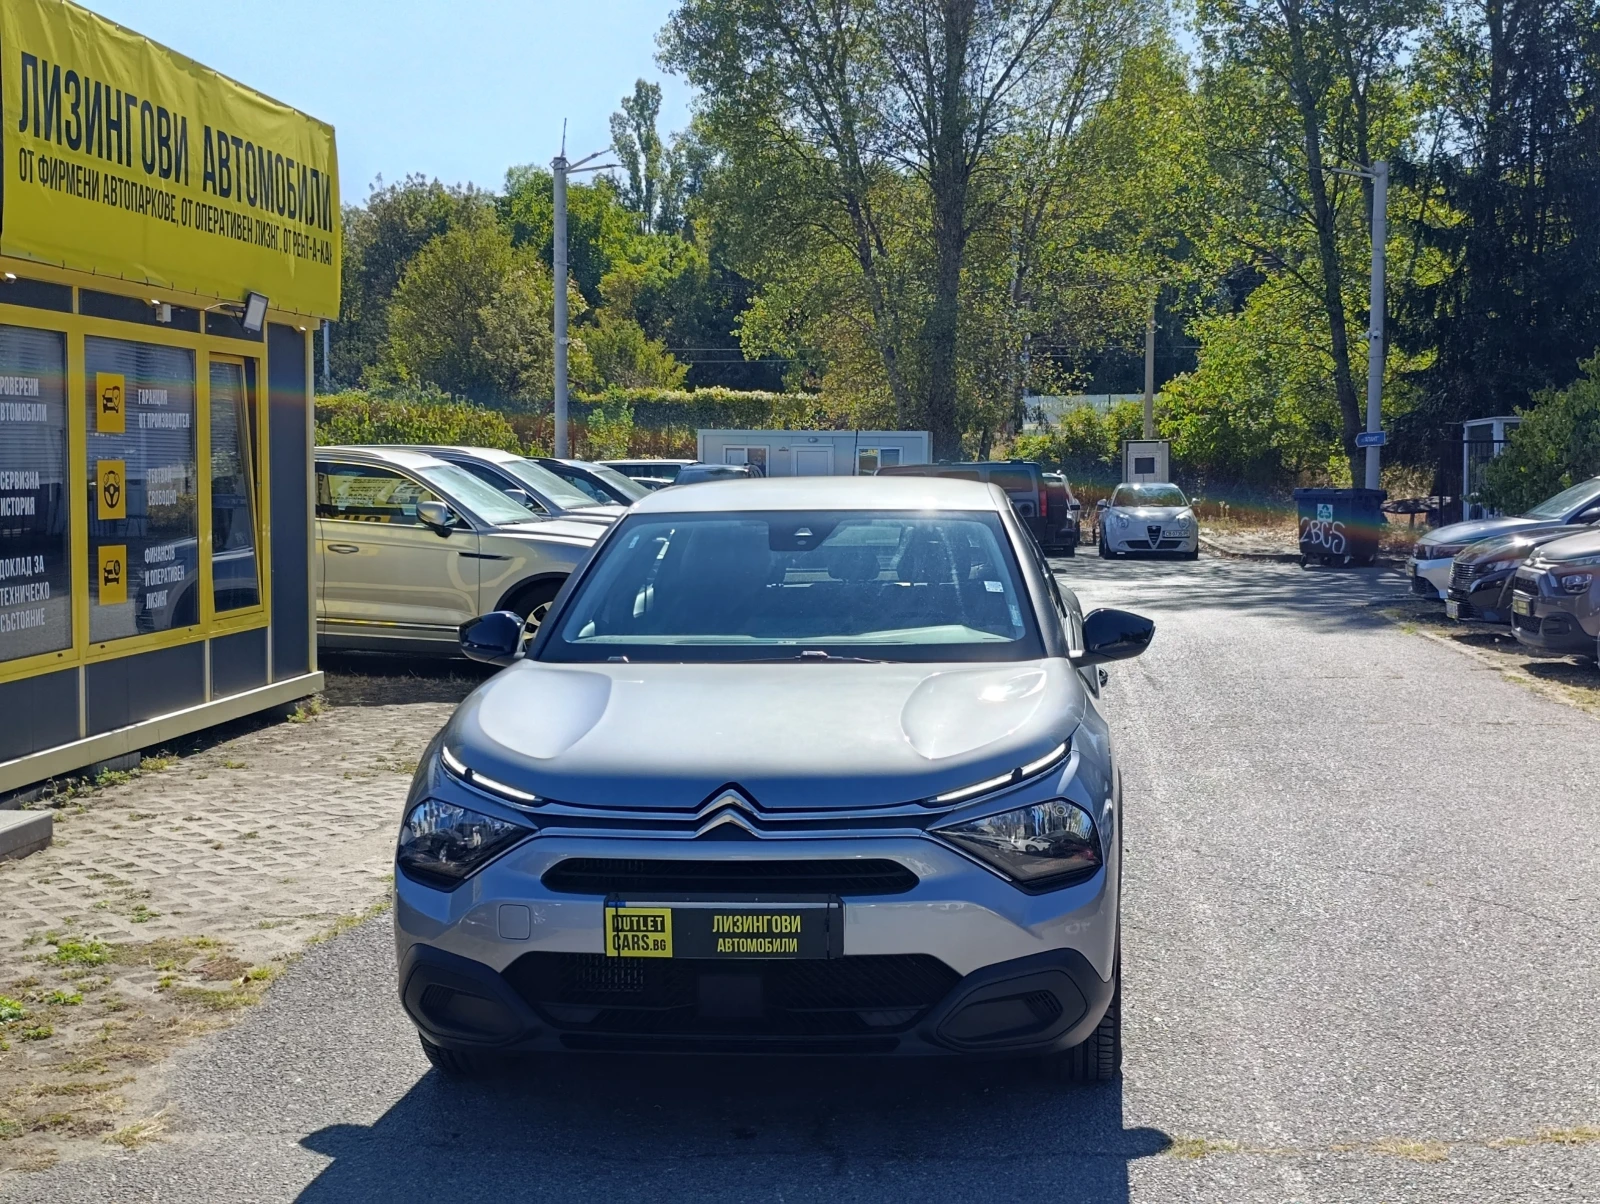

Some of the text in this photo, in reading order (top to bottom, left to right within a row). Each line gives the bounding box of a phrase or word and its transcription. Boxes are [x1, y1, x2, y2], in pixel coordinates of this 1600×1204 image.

[19, 51, 333, 233] ЛИЗИНГОВИ АВТОМОБИЛИ
[19, 147, 34, 184] ОТ
[38, 154, 100, 203] ФИРМЕНИ
[102, 173, 179, 228] АВТОПАРКОВЕ,
[181, 197, 193, 228] ОТ
[195, 201, 253, 244] ОПЕРАТИВЕН
[283, 227, 292, 254] ОТ
[138, 389, 168, 406] ГАРАНЦИЯ
[139, 412, 190, 430] ОТ ПРОИЗВОДИТЕЛ
[0, 471, 40, 490] СЕРВИЗНА
[0, 496, 35, 517] ИСТОРИЯ
[148, 490, 177, 507] СВОБОДНО
[144, 544, 176, 564] ФИНАНСОВ
[0, 555, 45, 580] ДОКЛАД ЗА
[145, 565, 185, 587] И ОПЕРАТИВЕН
[0, 581, 50, 606] ТЕХНИЧЕСКО
[146, 590, 168, 609] ЛИЗИНГ
[0, 607, 46, 633] СЪСТОЯНИЕ
[712, 915, 801, 933] ЛИЗИНГОВИ
[612, 933, 667, 952] CARS.BG
[717, 937, 798, 953] АВТОМОБИЛИ
